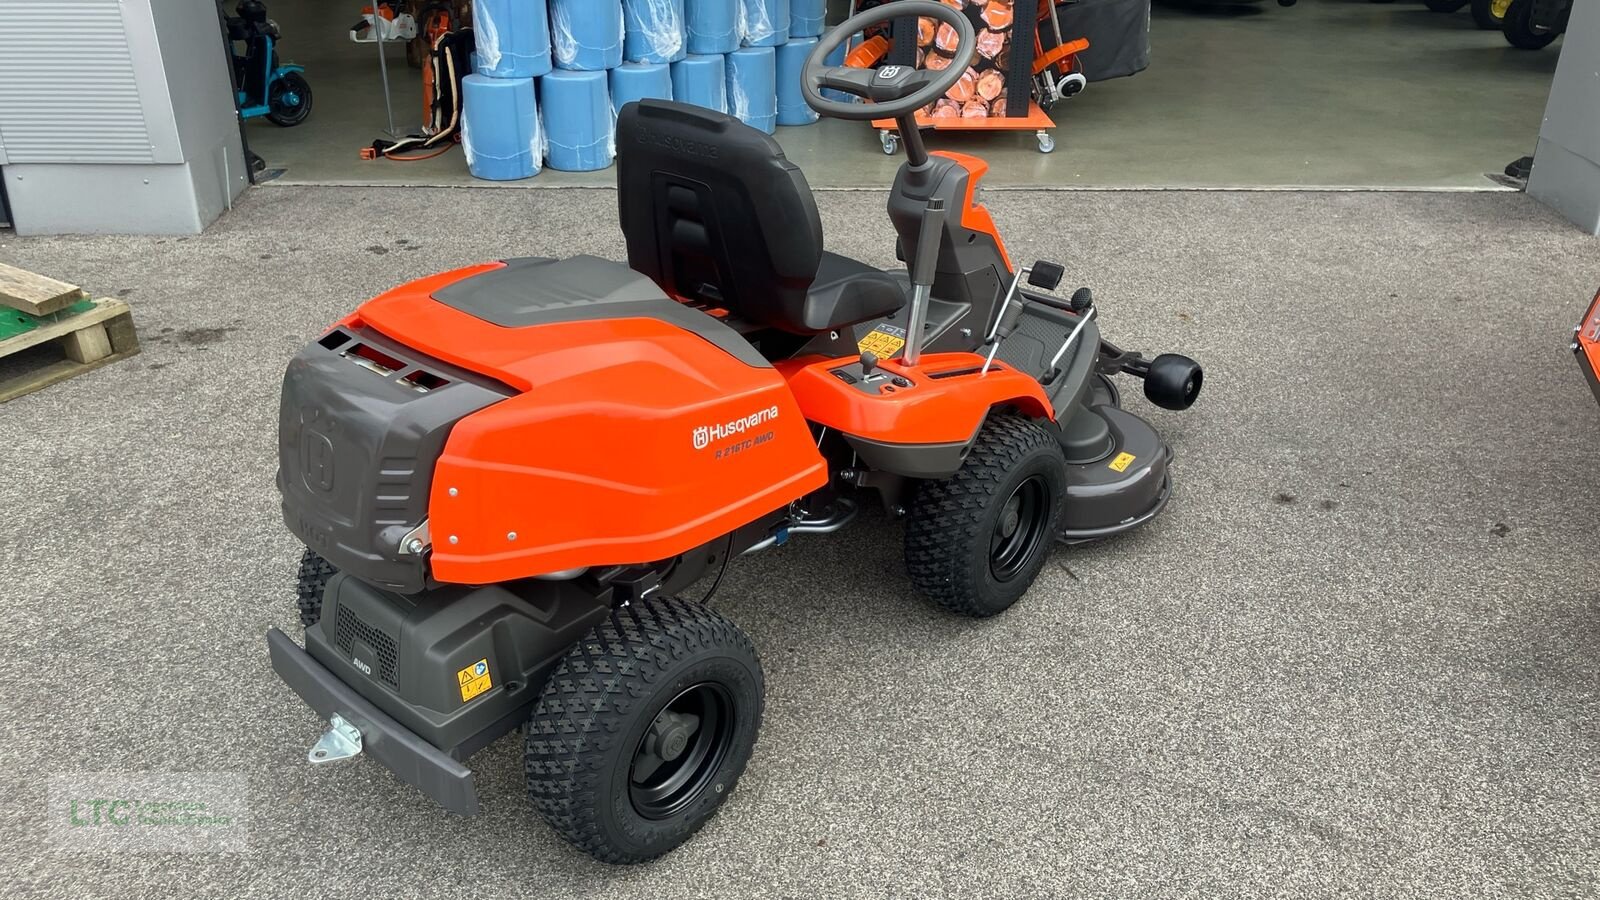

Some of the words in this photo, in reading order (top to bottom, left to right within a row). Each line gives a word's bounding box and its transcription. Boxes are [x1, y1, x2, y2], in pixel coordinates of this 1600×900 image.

[709, 405, 778, 442] Husqvarna
[715, 449, 722, 460] R
[753, 431, 775, 446] AWD
[353, 657, 371, 675] AWD
